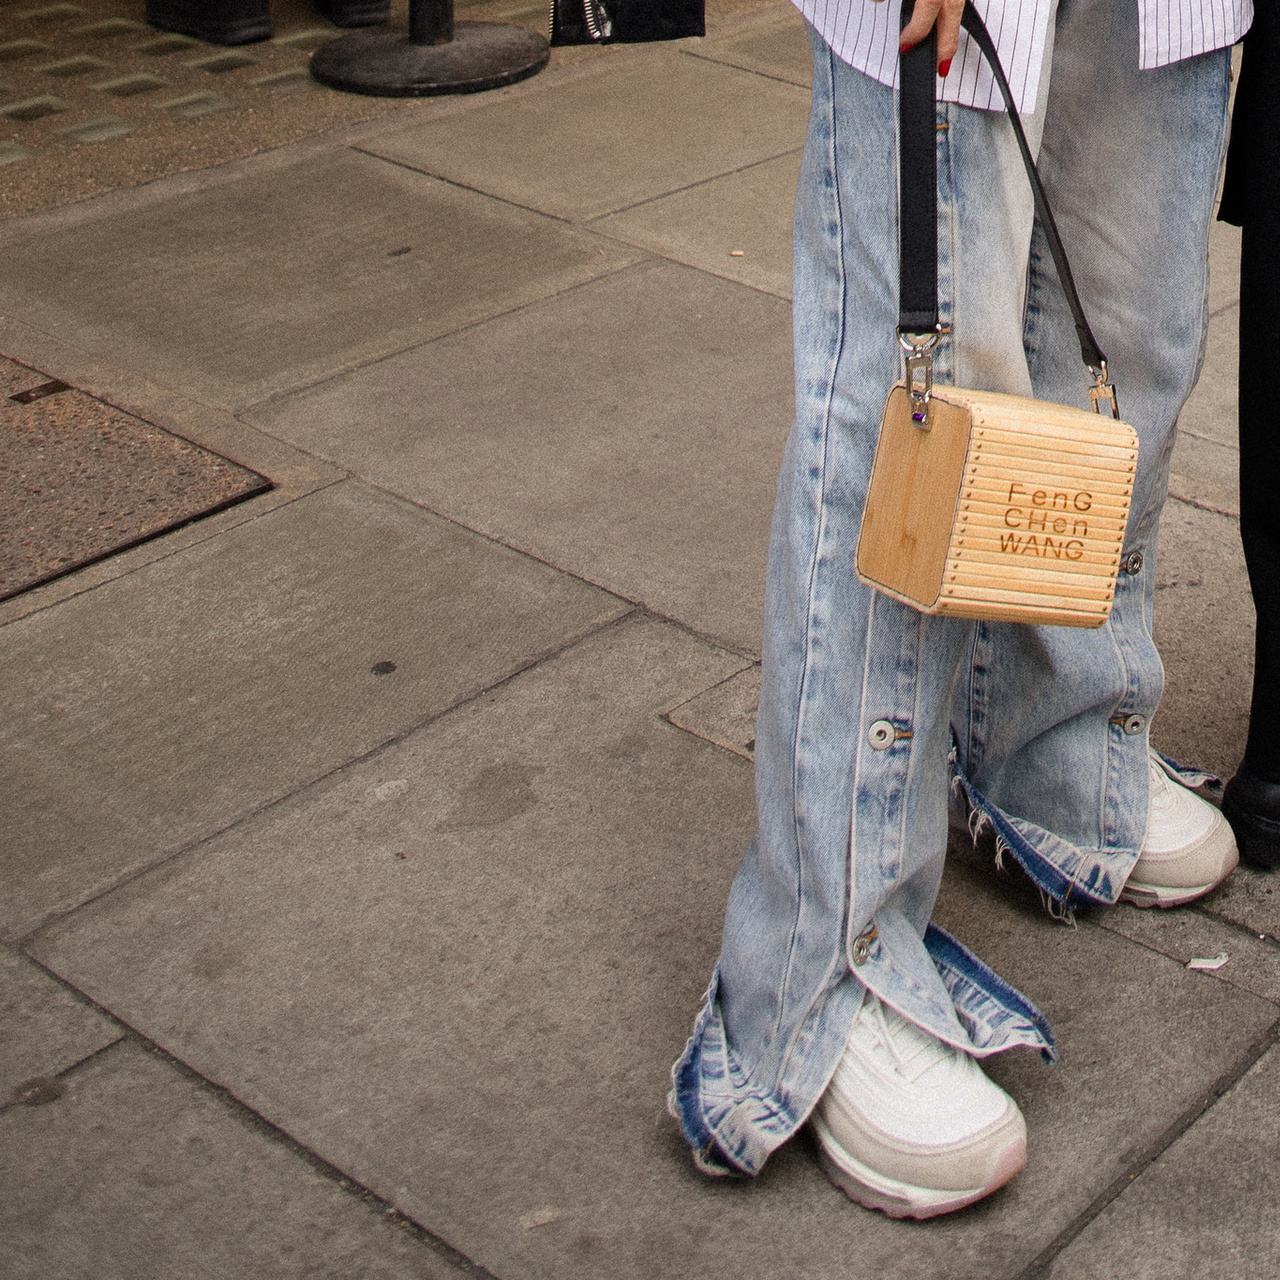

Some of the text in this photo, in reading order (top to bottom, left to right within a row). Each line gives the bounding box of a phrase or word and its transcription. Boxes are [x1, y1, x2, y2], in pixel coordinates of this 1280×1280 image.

[1008, 483, 1093, 511] FenG
[1004, 508, 1088, 535] CHen
[1000, 533, 1084, 560] WANG
